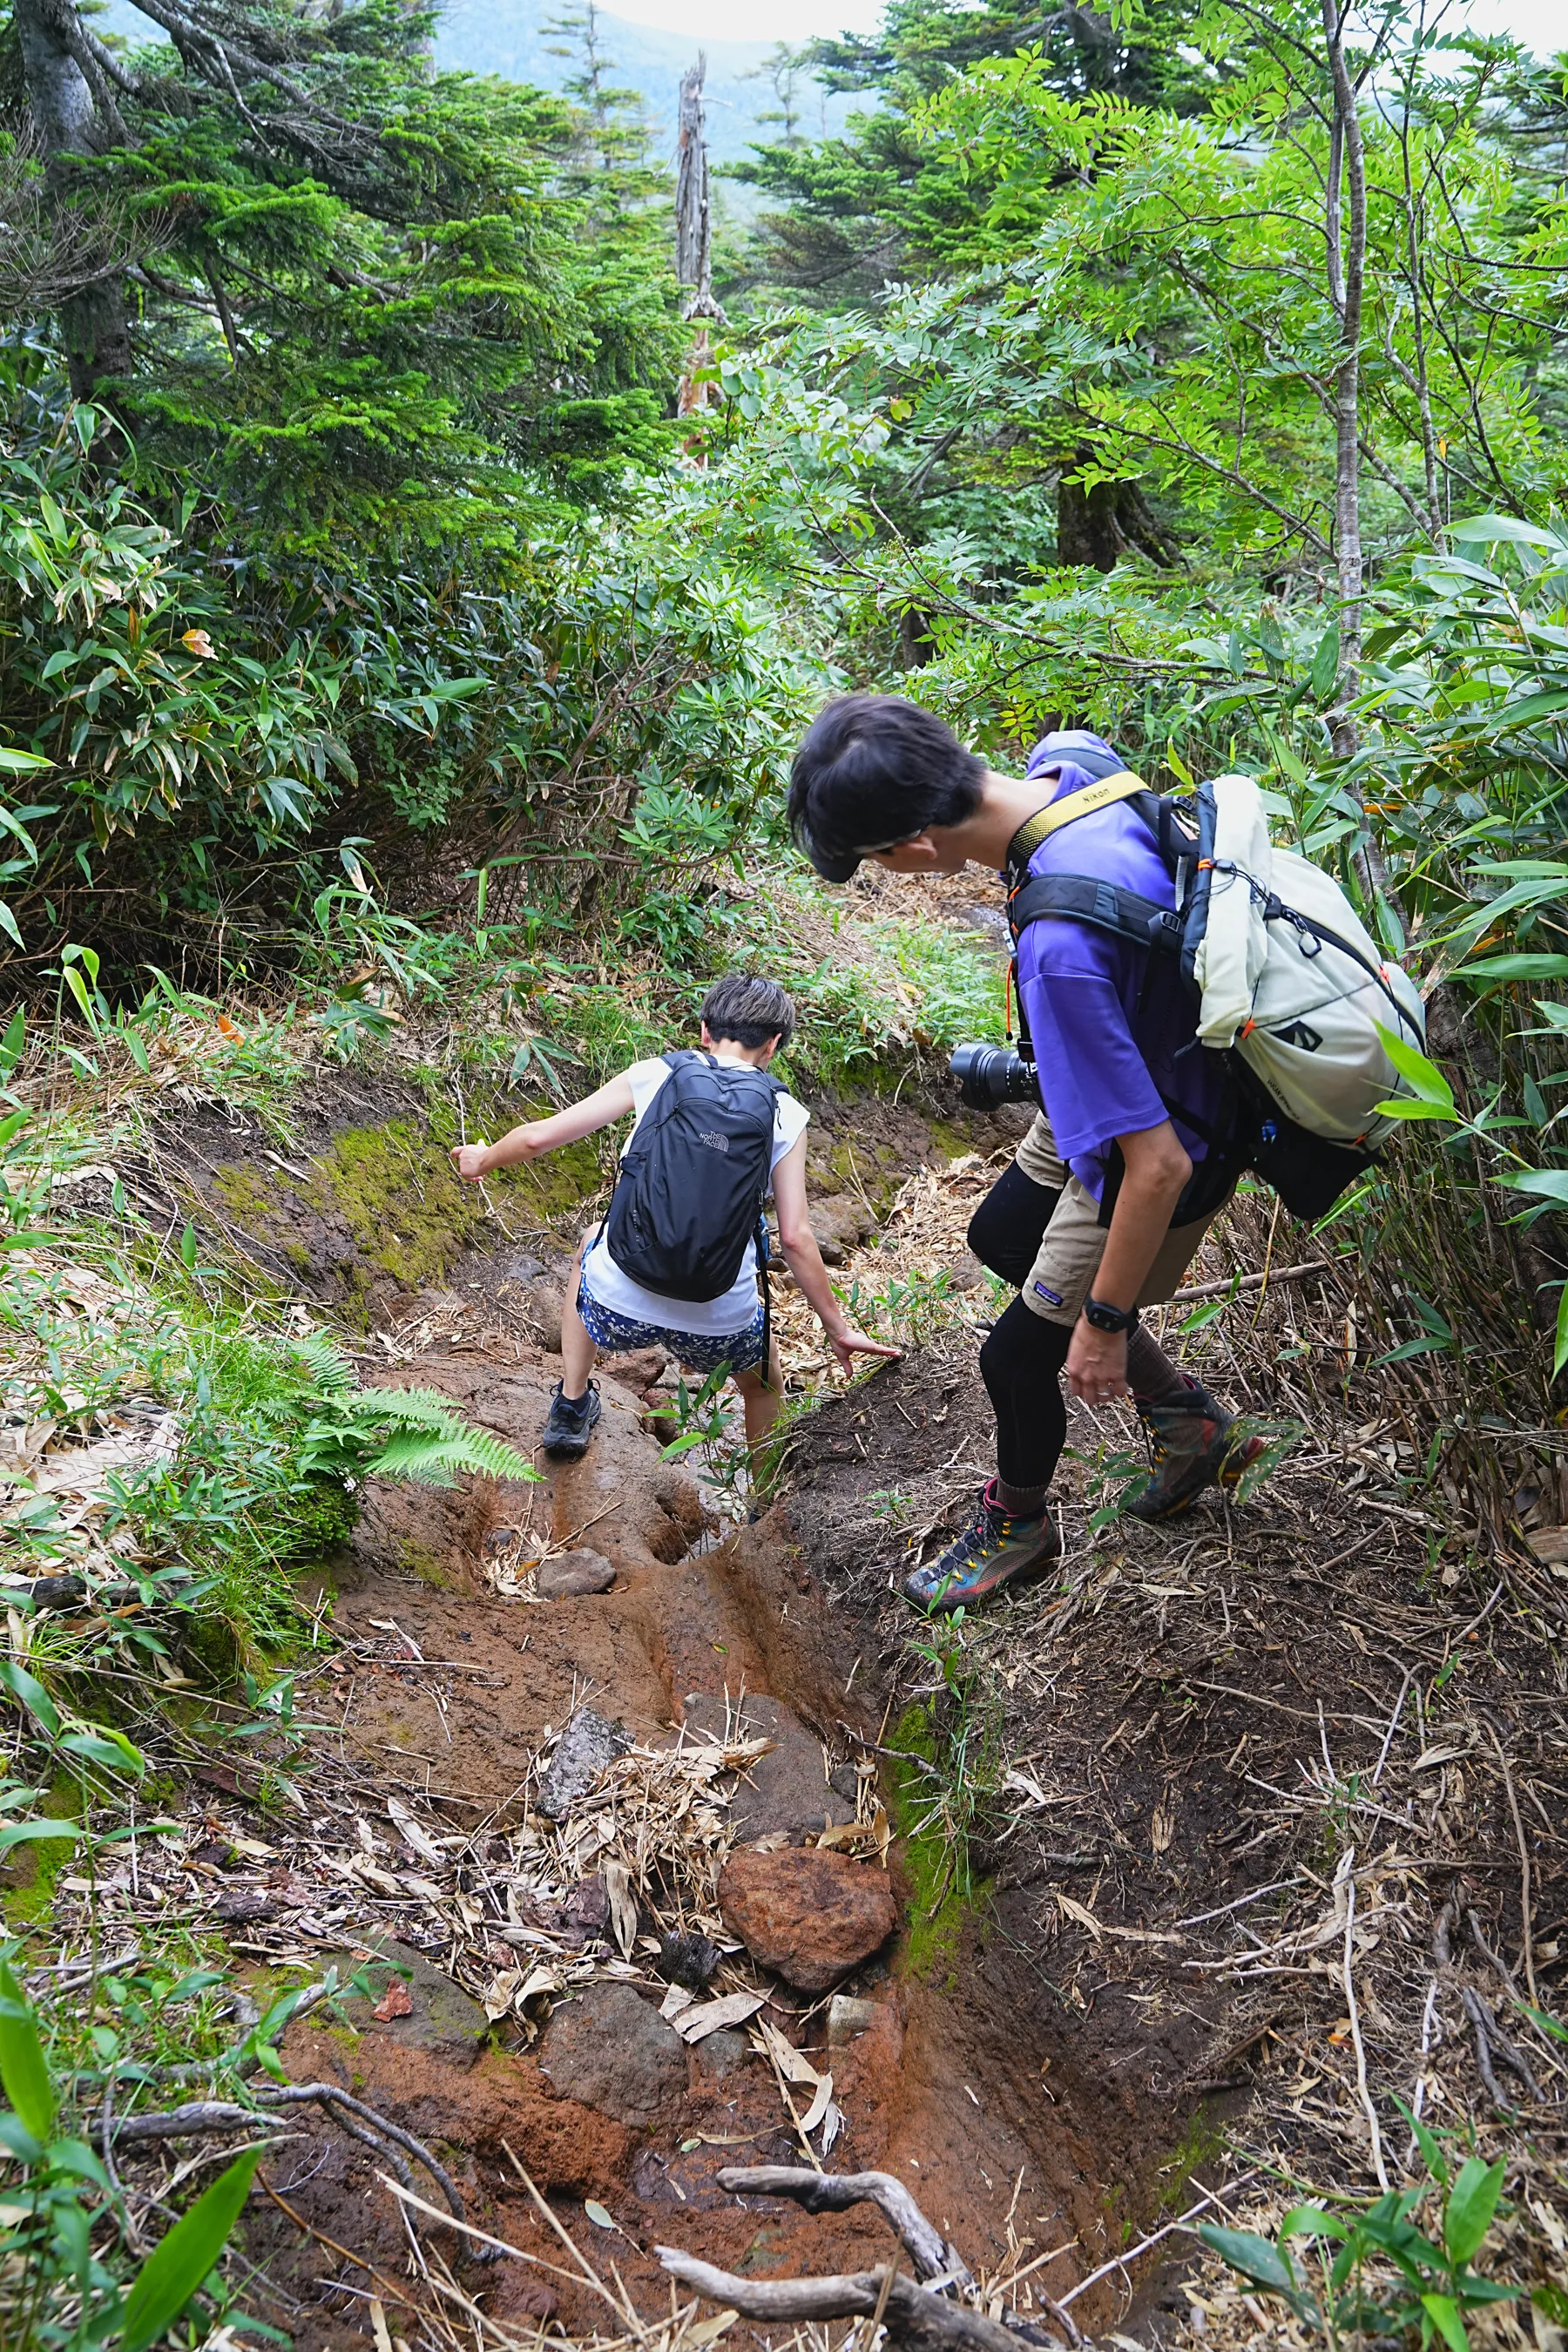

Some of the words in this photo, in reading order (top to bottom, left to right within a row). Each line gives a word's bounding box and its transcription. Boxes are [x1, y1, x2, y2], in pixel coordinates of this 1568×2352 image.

[1082, 788, 1111, 805] Nikon
[700, 1132, 720, 1144] NORTH
[710, 1131, 722, 1139] THE
[703, 1139, 720, 1150] FACE
